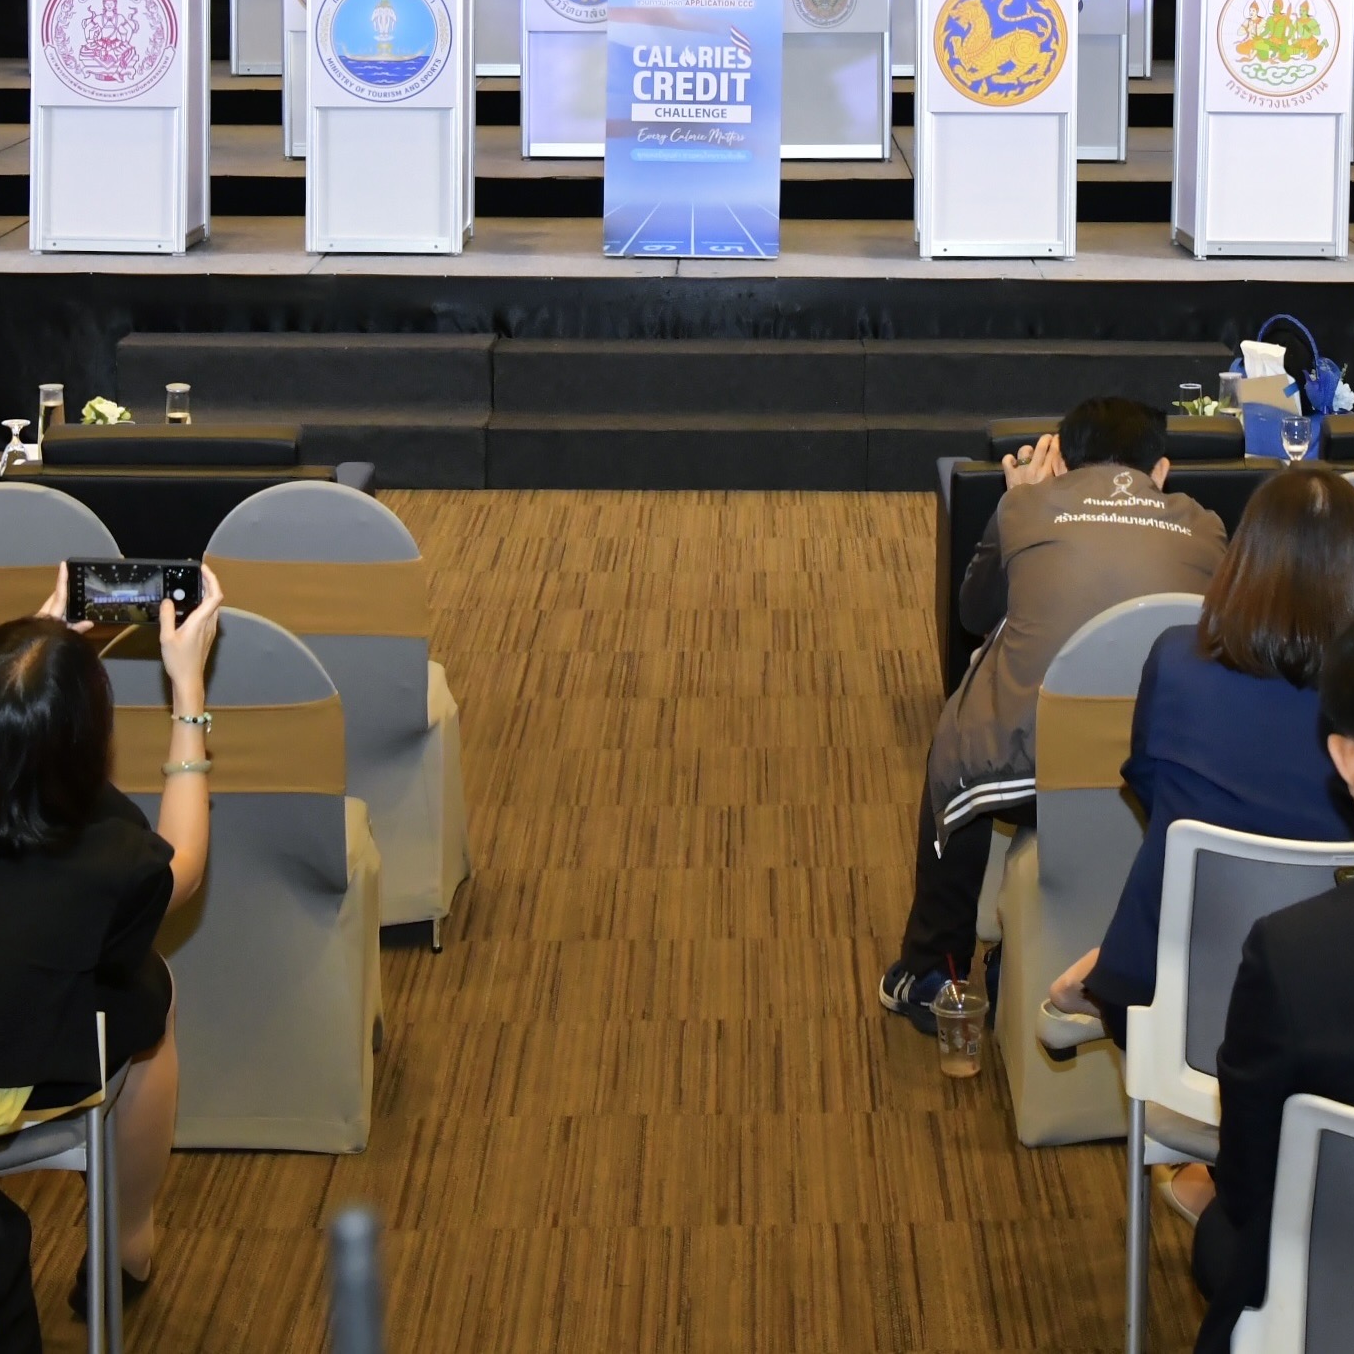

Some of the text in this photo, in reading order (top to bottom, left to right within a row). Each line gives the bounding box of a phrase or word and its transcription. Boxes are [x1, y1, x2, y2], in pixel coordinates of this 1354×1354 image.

[685, 0, 736, 7] APPLICATION
[632, 44, 752, 69] CALORIES
[326, 57, 442, 98] MINISTRY OF TOURISM AND SPORTS
[633, 70, 751, 102] CREDIT
[1225, 80, 1329, 109] กระทรวงแรงงาน
[654, 107, 728, 119] CHALLENGE
[637, 127, 745, 146] Every Calorie Matters
